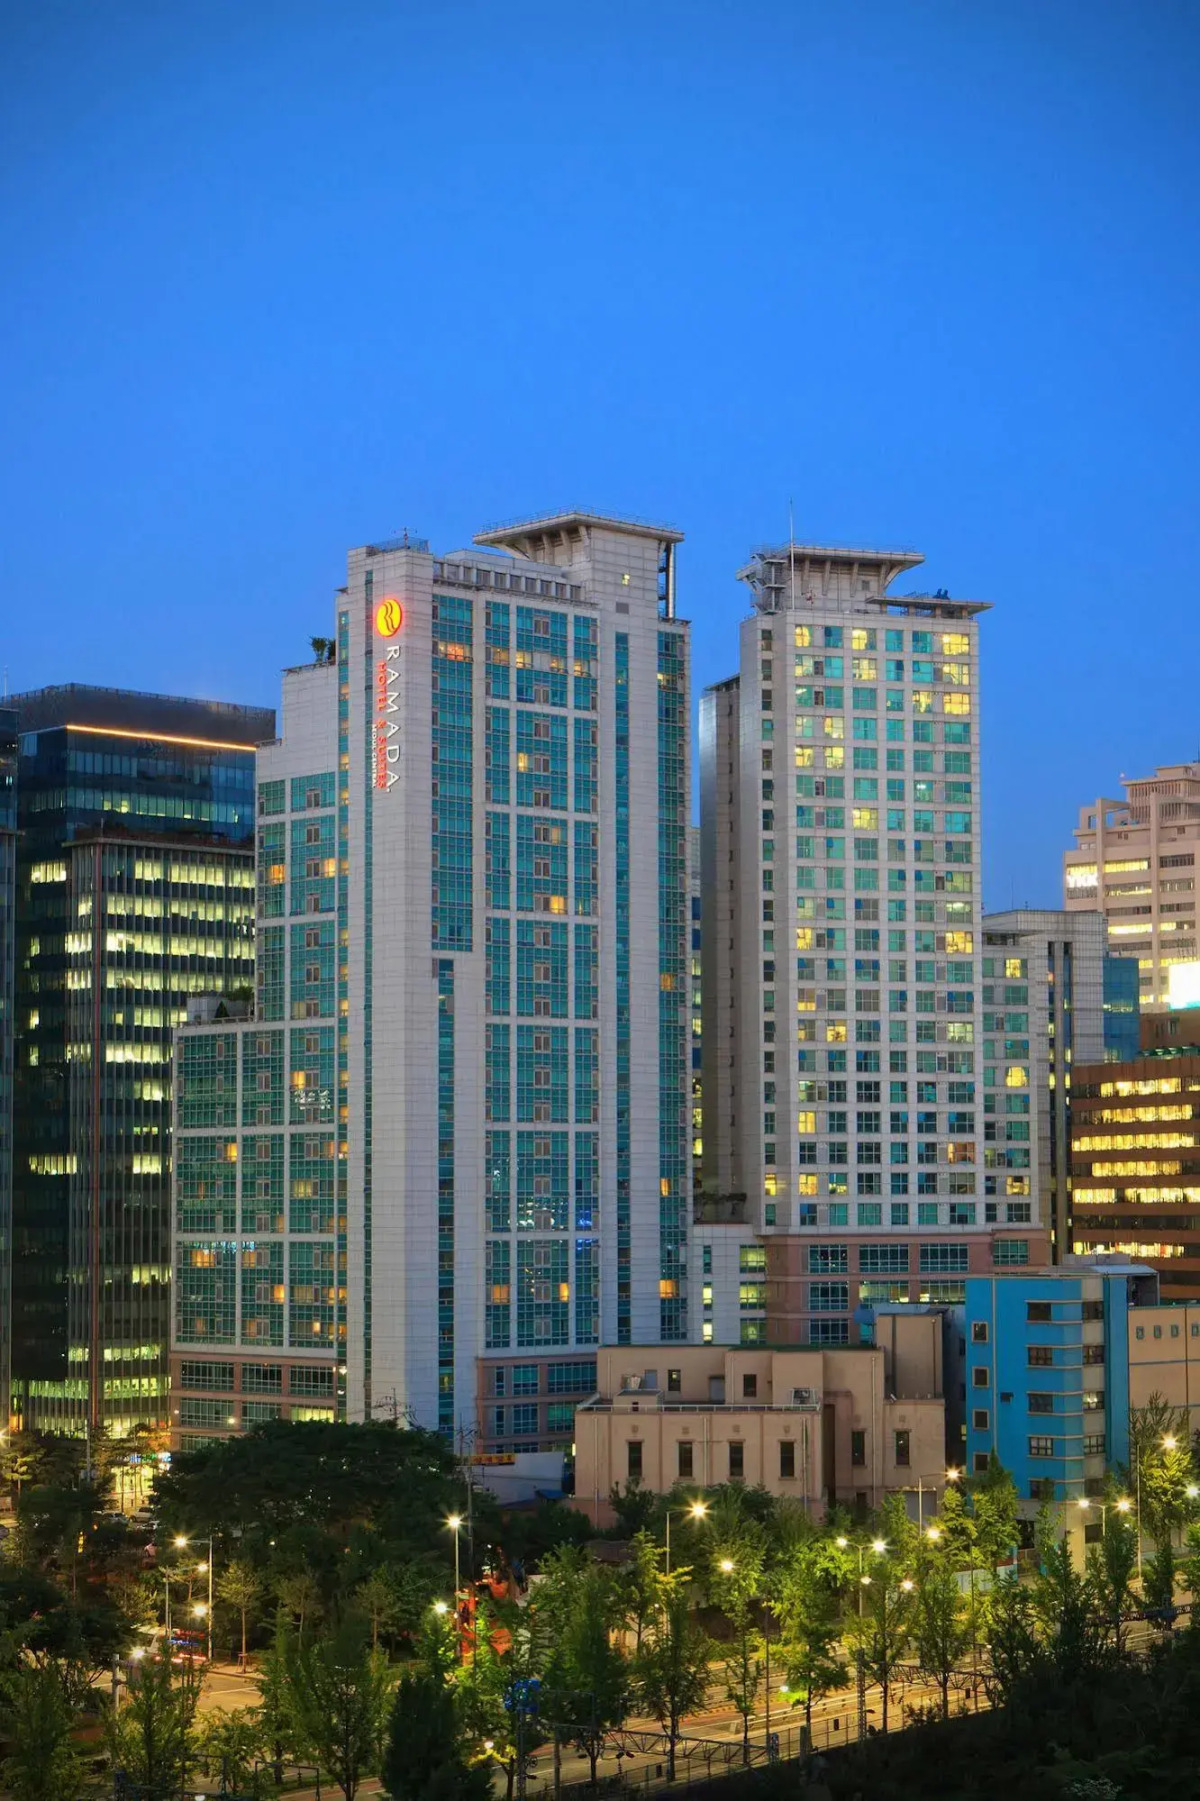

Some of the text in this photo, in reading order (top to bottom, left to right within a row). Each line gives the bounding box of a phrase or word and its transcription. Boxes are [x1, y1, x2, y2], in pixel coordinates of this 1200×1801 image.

[377, 662, 387, 789] HOTEL & SUITES
[387, 645, 400, 788] RAMADA
